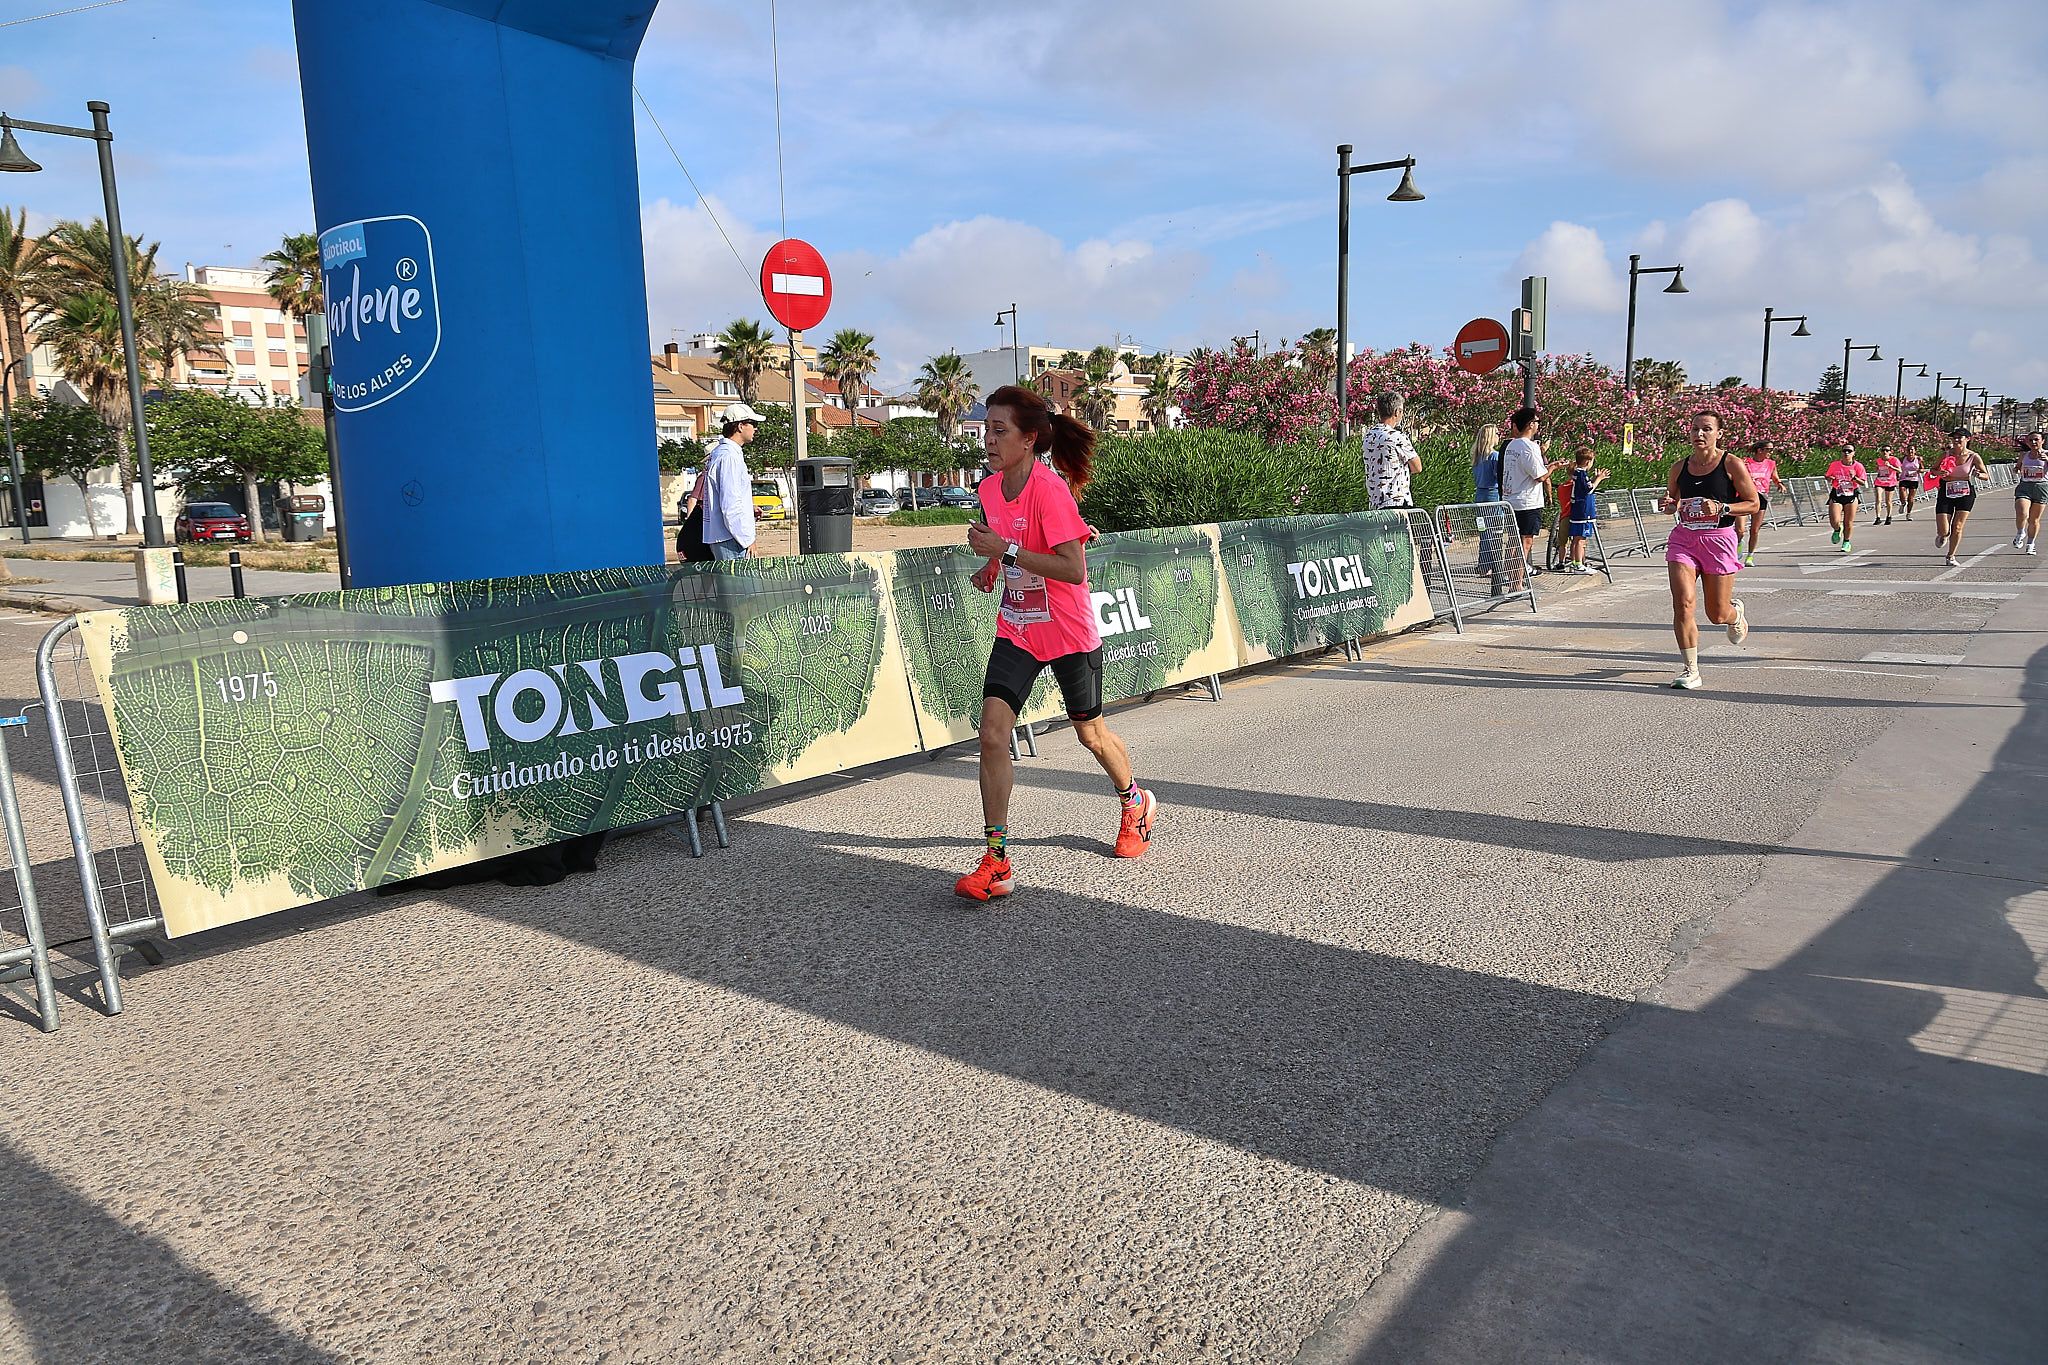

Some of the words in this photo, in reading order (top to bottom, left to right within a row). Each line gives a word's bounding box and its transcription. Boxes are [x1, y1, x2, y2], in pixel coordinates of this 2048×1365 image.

[336, 384, 346, 399] DE
[347, 383, 368, 399] LOS
[371, 353, 413, 393] ALPES
[1240, 553, 1255, 568] 1975
[1173, 568, 1192, 583] 2026
[931, 592, 955, 611] 1975
[1090, 587, 1152, 638] GiL
[1297, 602, 1331, 621] Cuidando
[1331, 600, 1340, 613] de
[1339, 599, 1347, 612] ti
[1346, 595, 1365, 610] desde
[1364, 594, 1379, 609] 1975
[800, 614, 832, 636] 2026
[1107, 641, 1136, 663] desde
[1137, 639, 1159, 658] 1975
[216, 671, 279, 703] 1975
[452, 752, 584, 800] Cuidando
[590, 744, 618, 771] de
[623, 738, 641, 764] ti
[645, 728, 706, 760] desde
[711, 721, 753, 749] 1975
